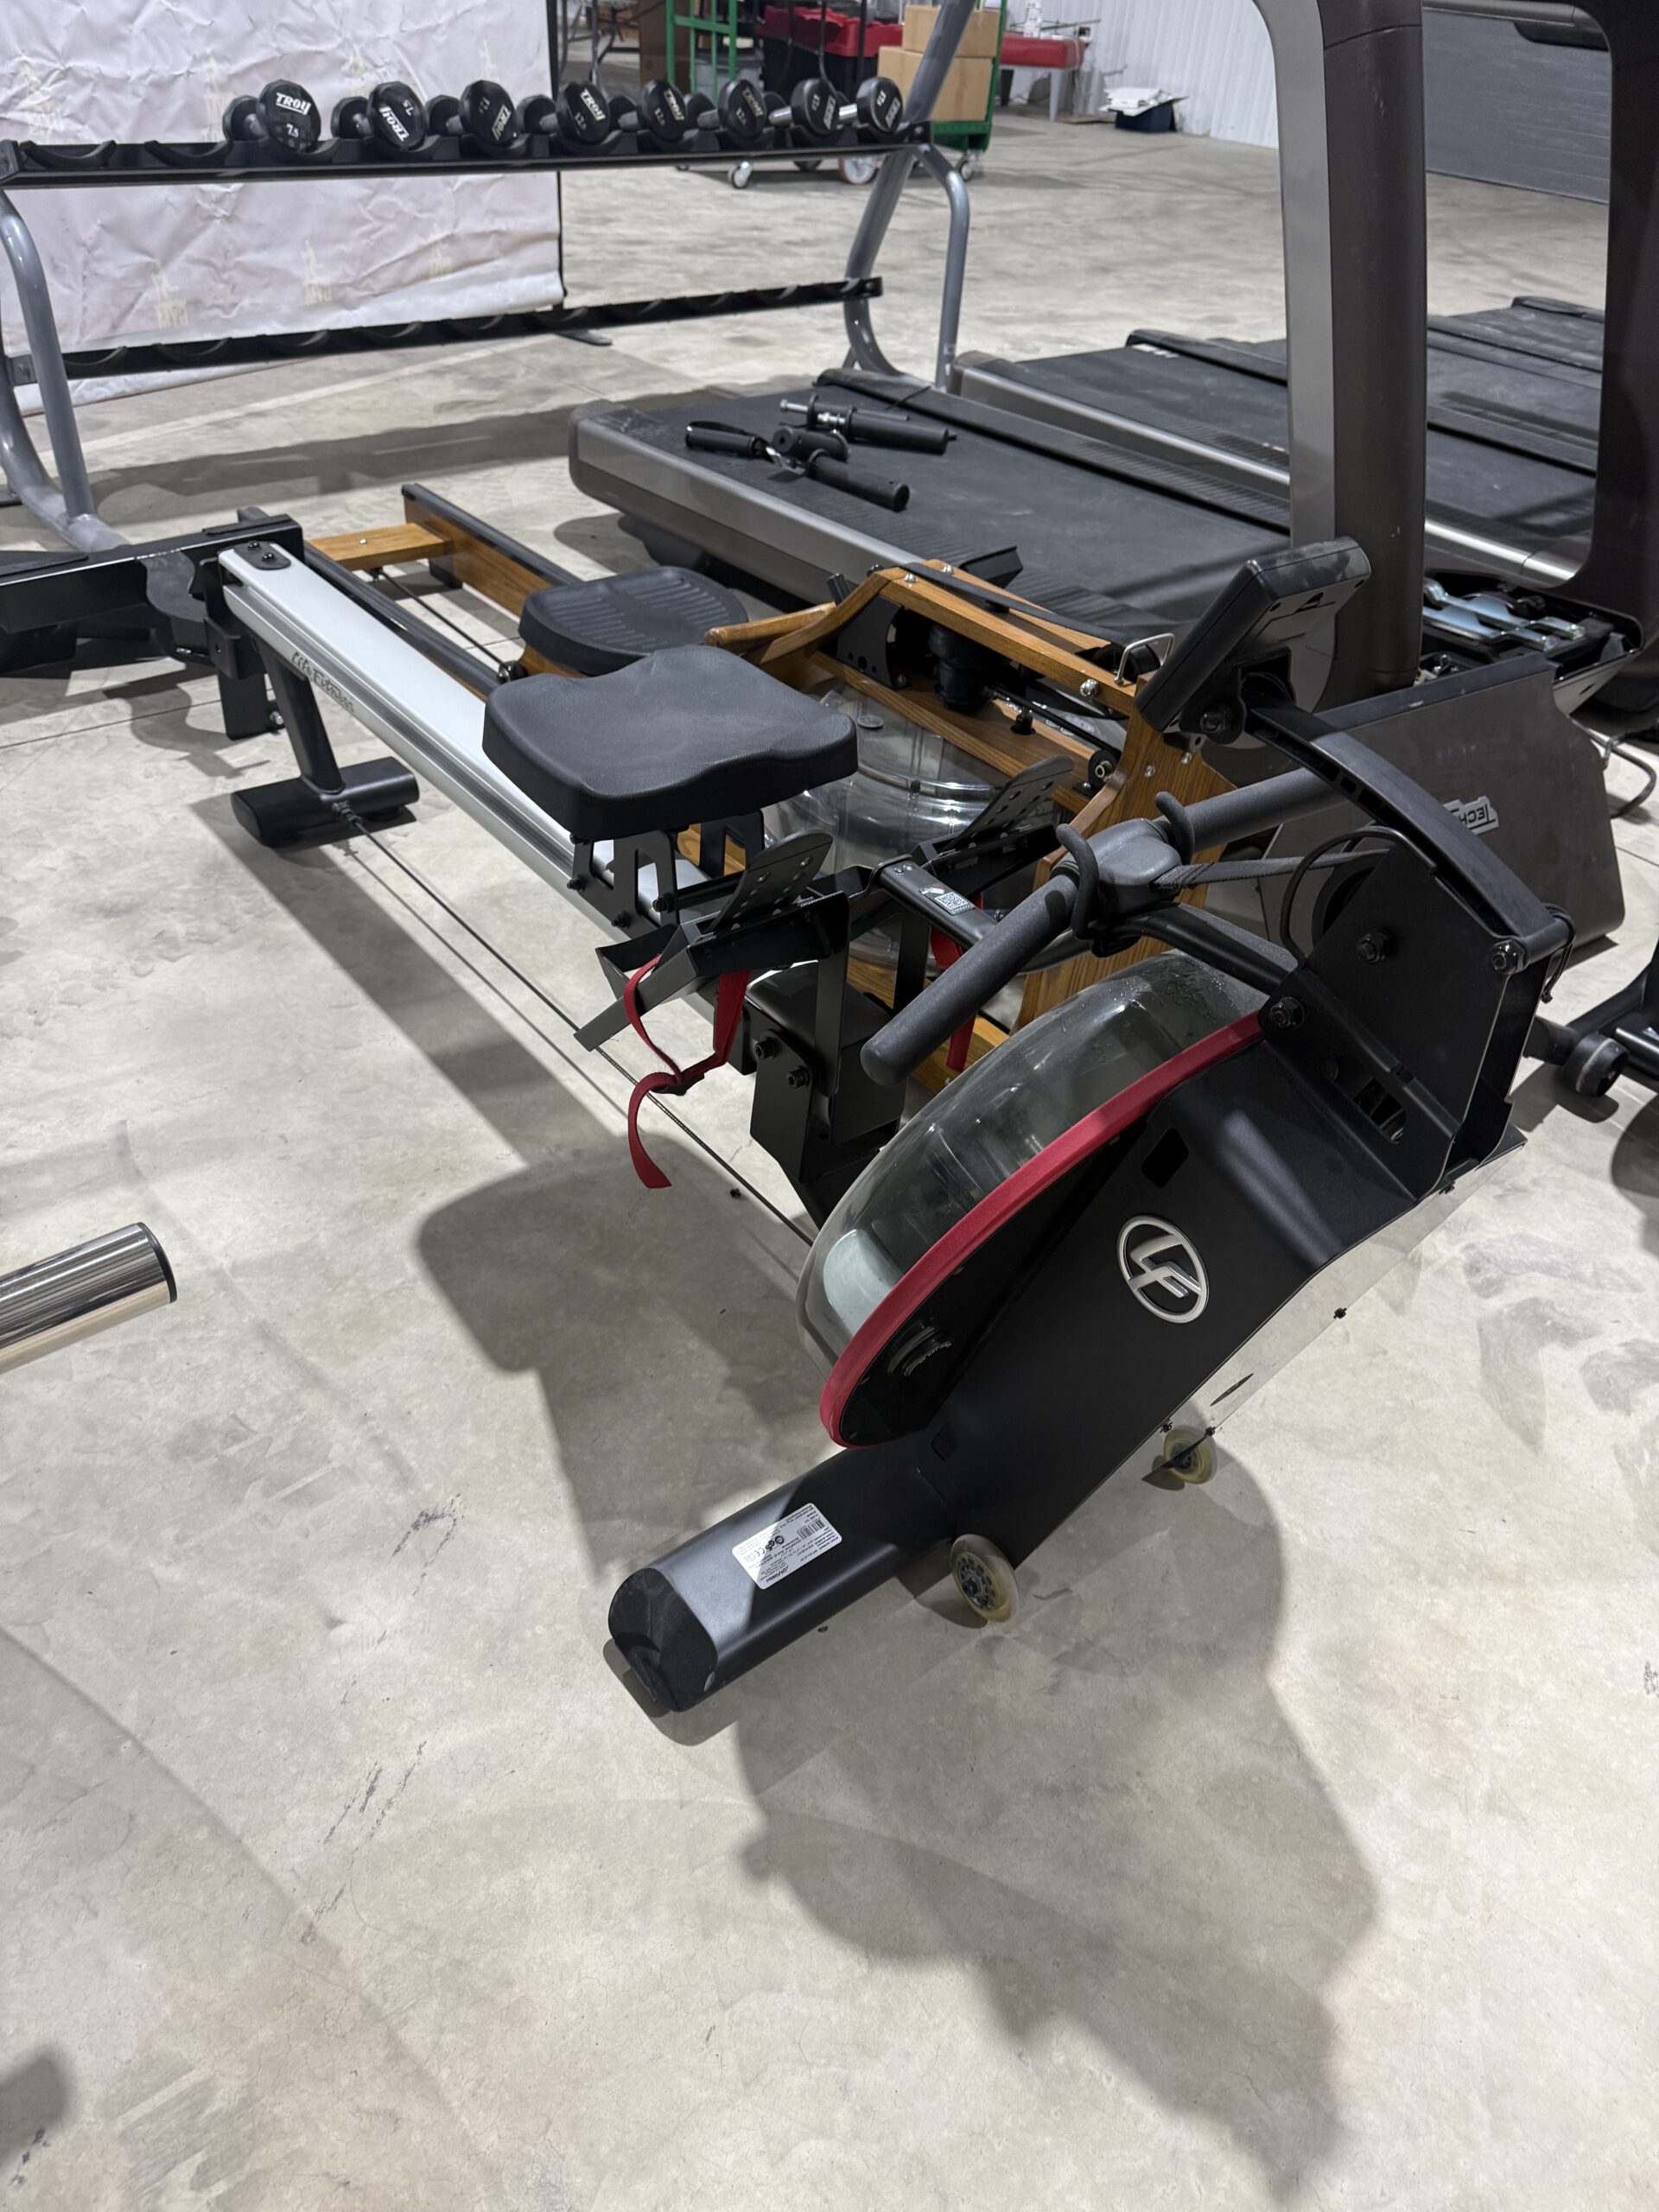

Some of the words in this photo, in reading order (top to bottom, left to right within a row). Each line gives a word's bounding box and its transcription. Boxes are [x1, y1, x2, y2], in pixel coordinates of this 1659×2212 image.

[276, 92, 312, 116] TROY
[491, 104, 512, 141] TROY
[378, 105, 410, 143] TROY
